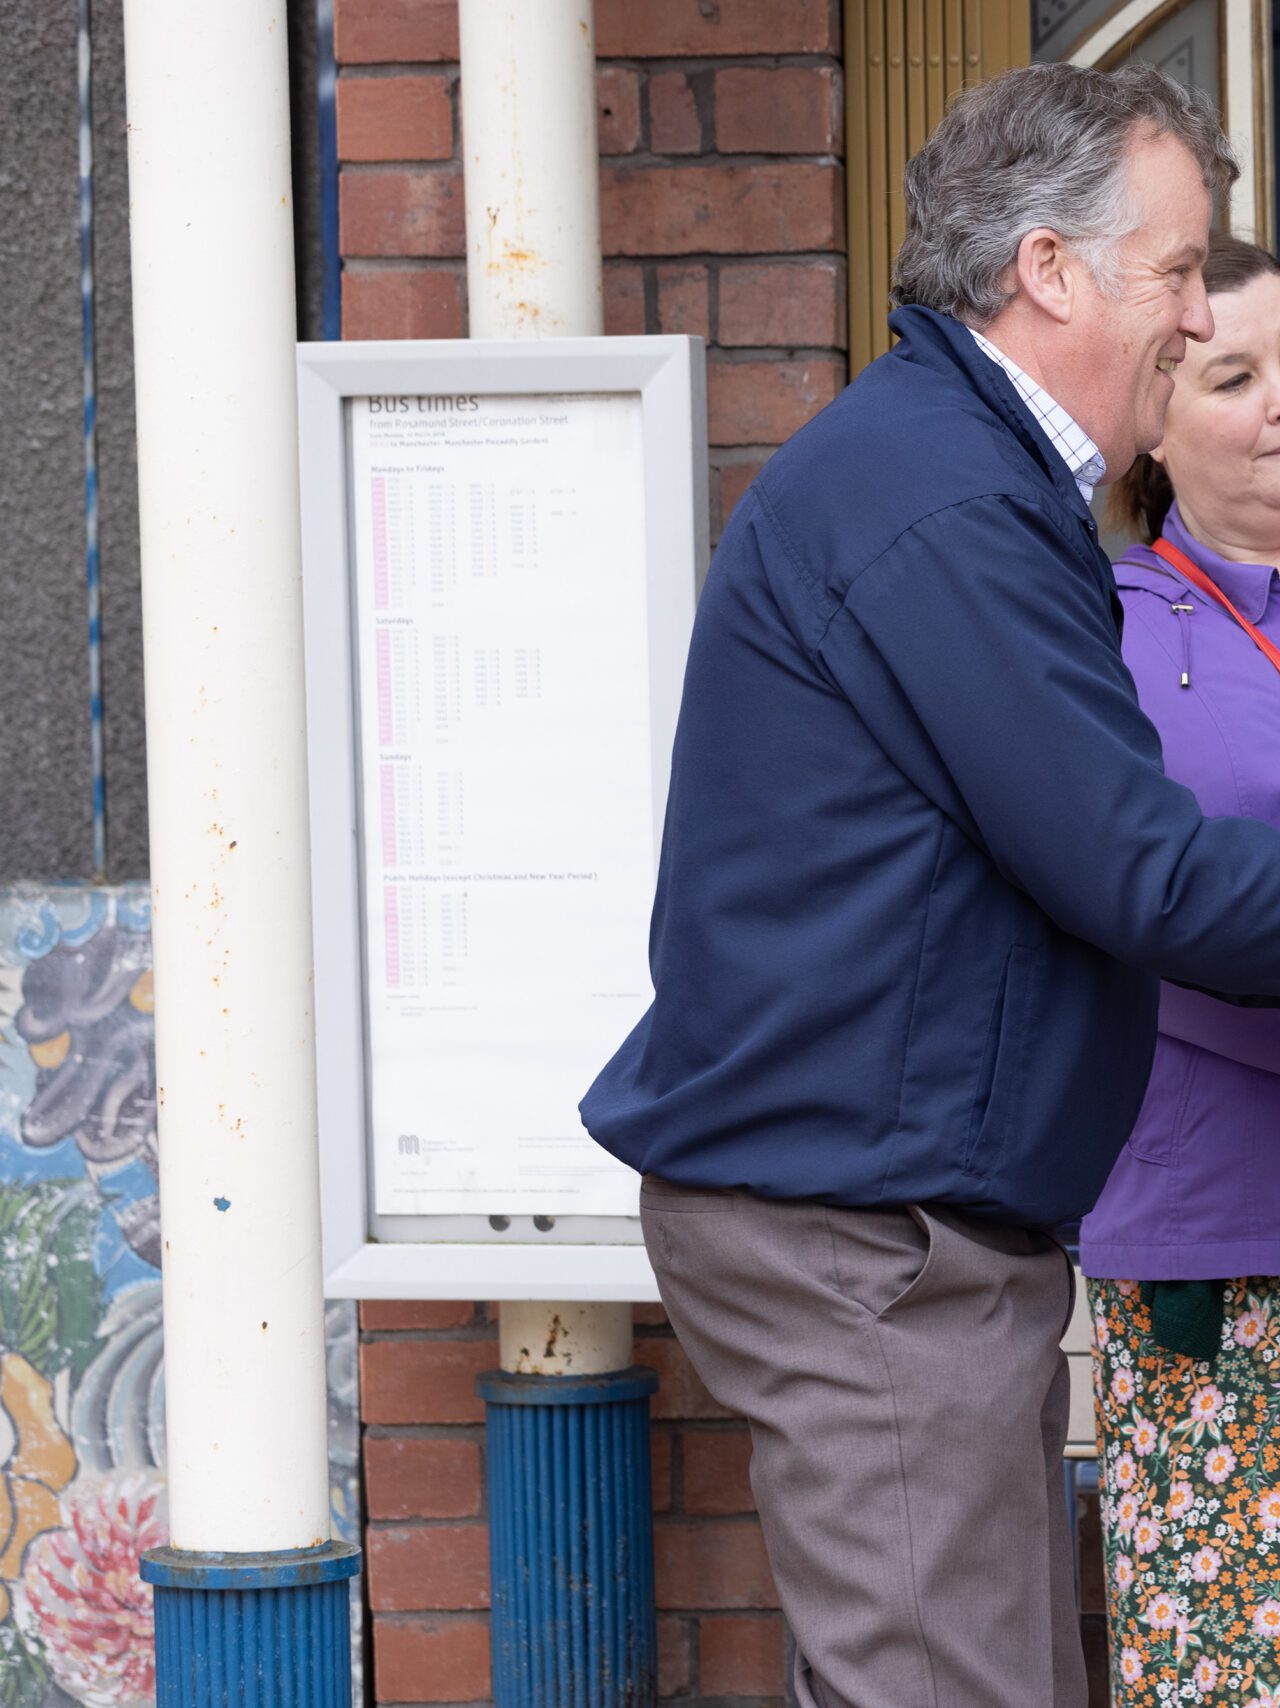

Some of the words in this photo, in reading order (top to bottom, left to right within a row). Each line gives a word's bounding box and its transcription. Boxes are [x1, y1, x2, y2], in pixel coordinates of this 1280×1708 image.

[369, 395, 409, 413] Bus
[416, 394, 479, 413] times
[370, 419, 393, 430] from
[395, 417, 447, 429] Rosamund
[539, 414, 569, 426] Street
[371, 465, 404, 475] Mondays
[416, 464, 445, 475] Fridays
[375, 617, 414, 625] Saturdays
[379, 753, 412, 762] Sundays
[383, 873, 406, 882] Public
[408, 873, 441, 883] Holidays
[474, 872, 511, 881] Christmas
[529, 872, 547, 881] New
[548, 872, 565, 881] Year
